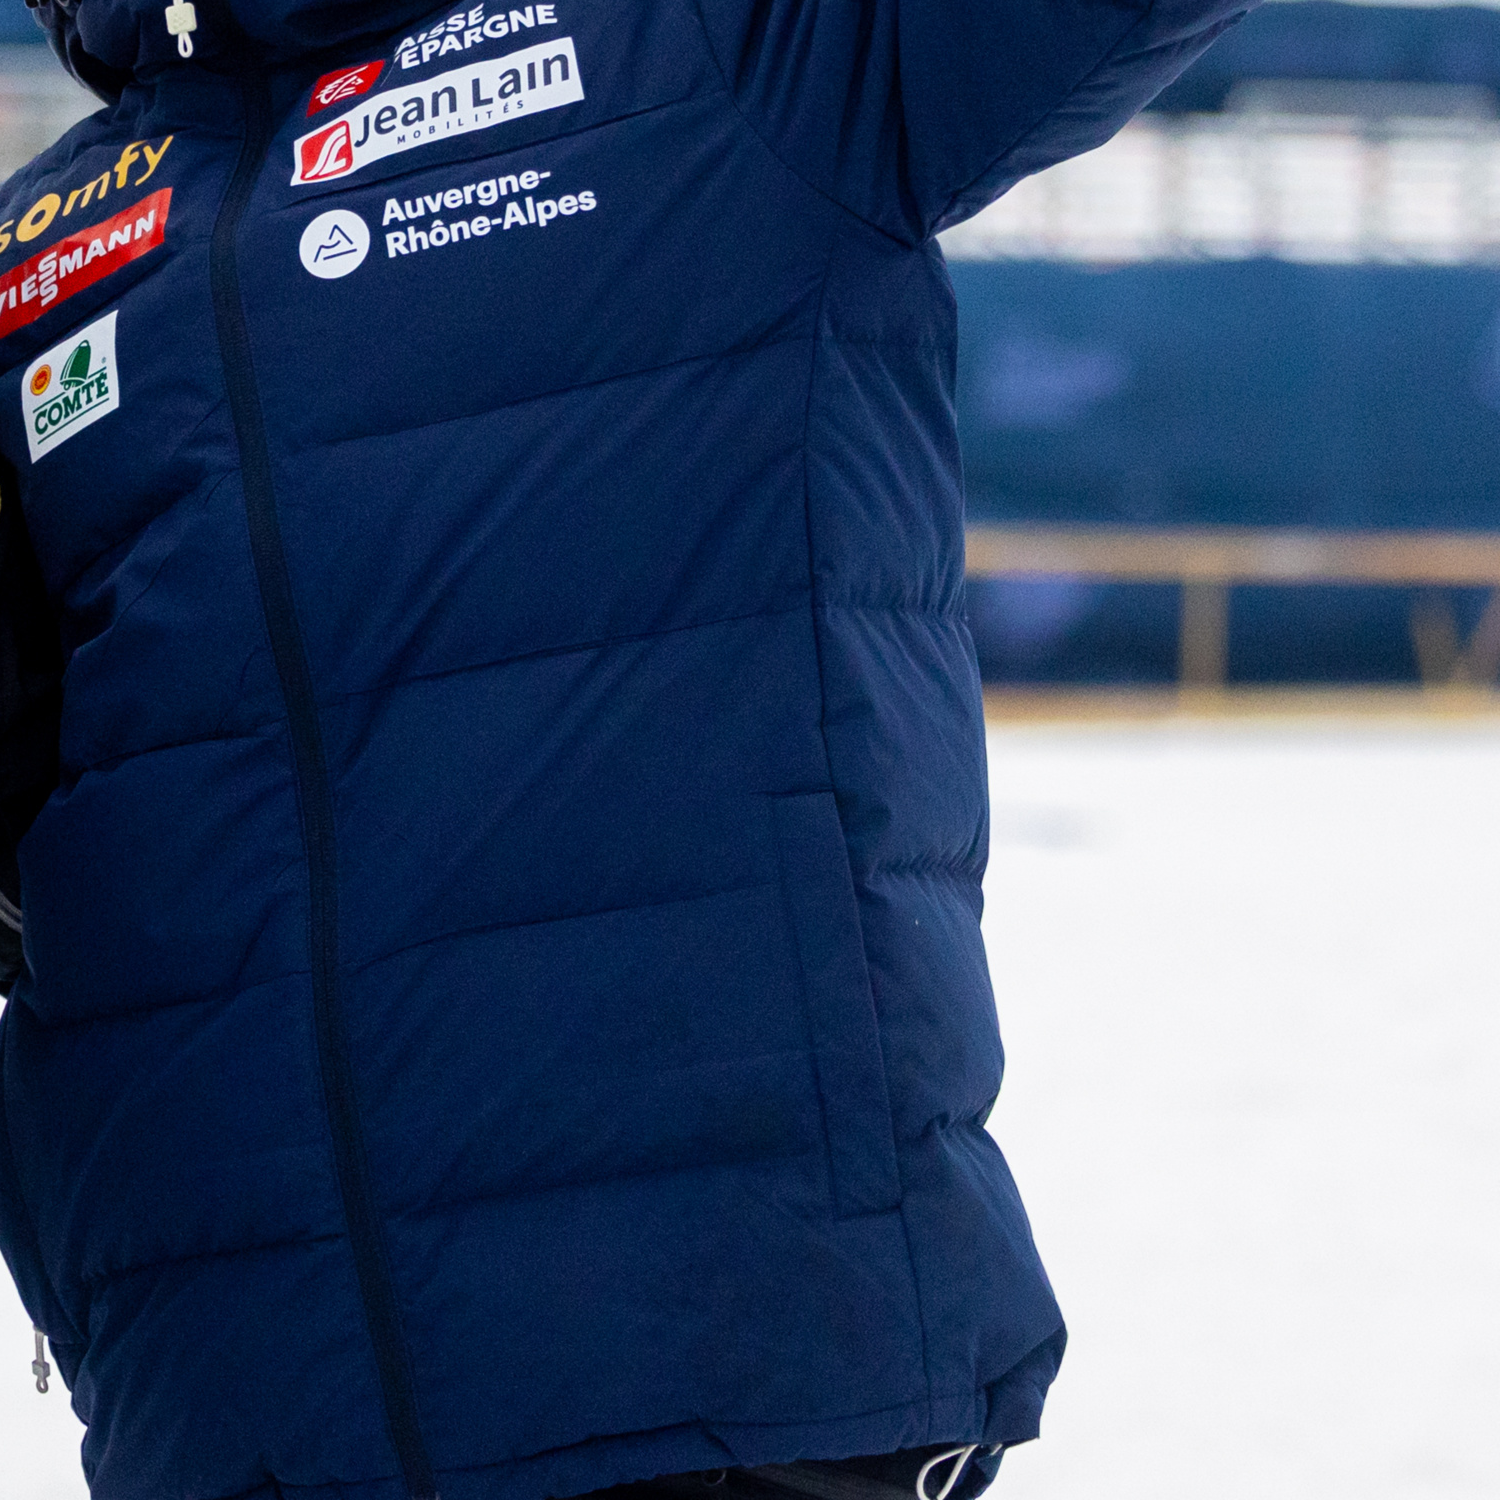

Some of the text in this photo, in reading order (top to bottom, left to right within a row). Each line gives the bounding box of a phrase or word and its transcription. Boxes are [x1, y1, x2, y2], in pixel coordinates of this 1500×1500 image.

[394, 4, 558, 70] EPARGNE
[395, 3, 485, 55] AISSE
[353, 53, 570, 148] Jean Lain
[397, 100, 524, 145] MOBILITÉS
[382, 169, 551, 227] Auvergne-
[385, 190, 597, 259] Rhône-Alpes
